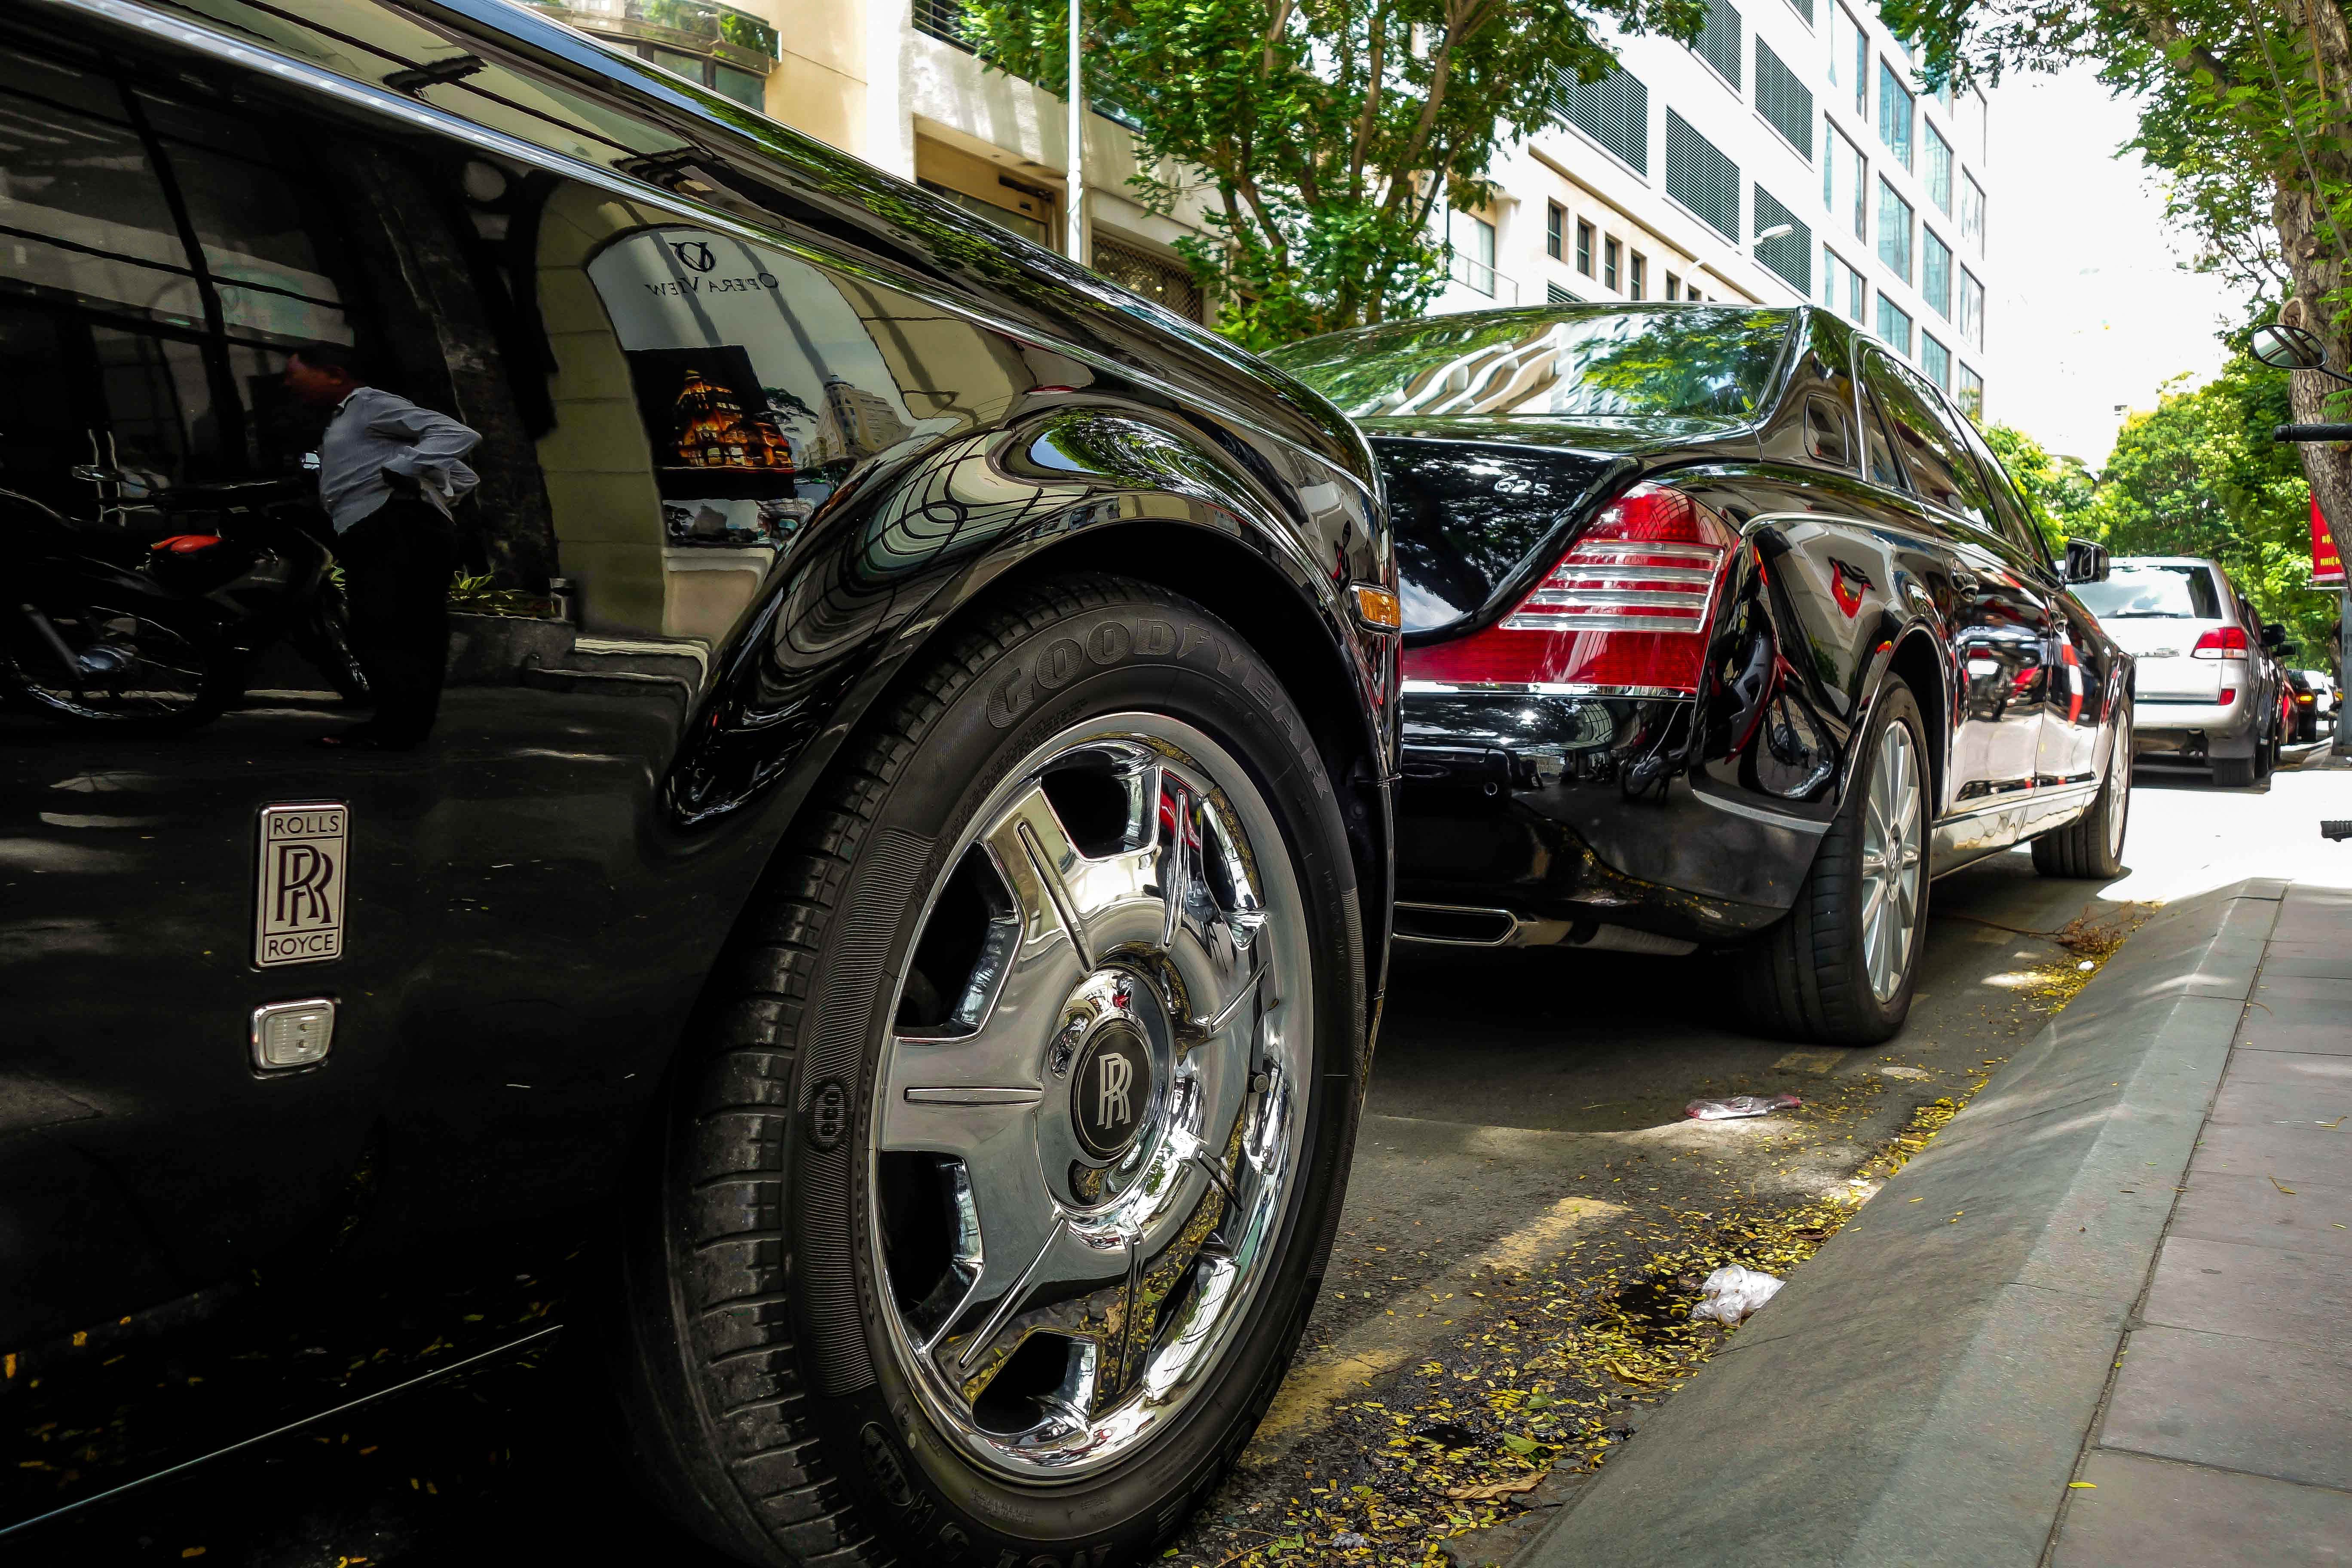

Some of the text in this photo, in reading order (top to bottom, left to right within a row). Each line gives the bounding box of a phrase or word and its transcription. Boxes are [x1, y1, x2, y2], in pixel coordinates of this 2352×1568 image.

[2322, 534, 2333, 544] HỘ
[987, 619, 1331, 799] GOODYEAR
[273, 814, 340, 834] ROLLS
[275, 843, 334, 927] RR
[267, 933, 334, 958] ROYCE
[1096, 1052, 1133, 1130] RR
